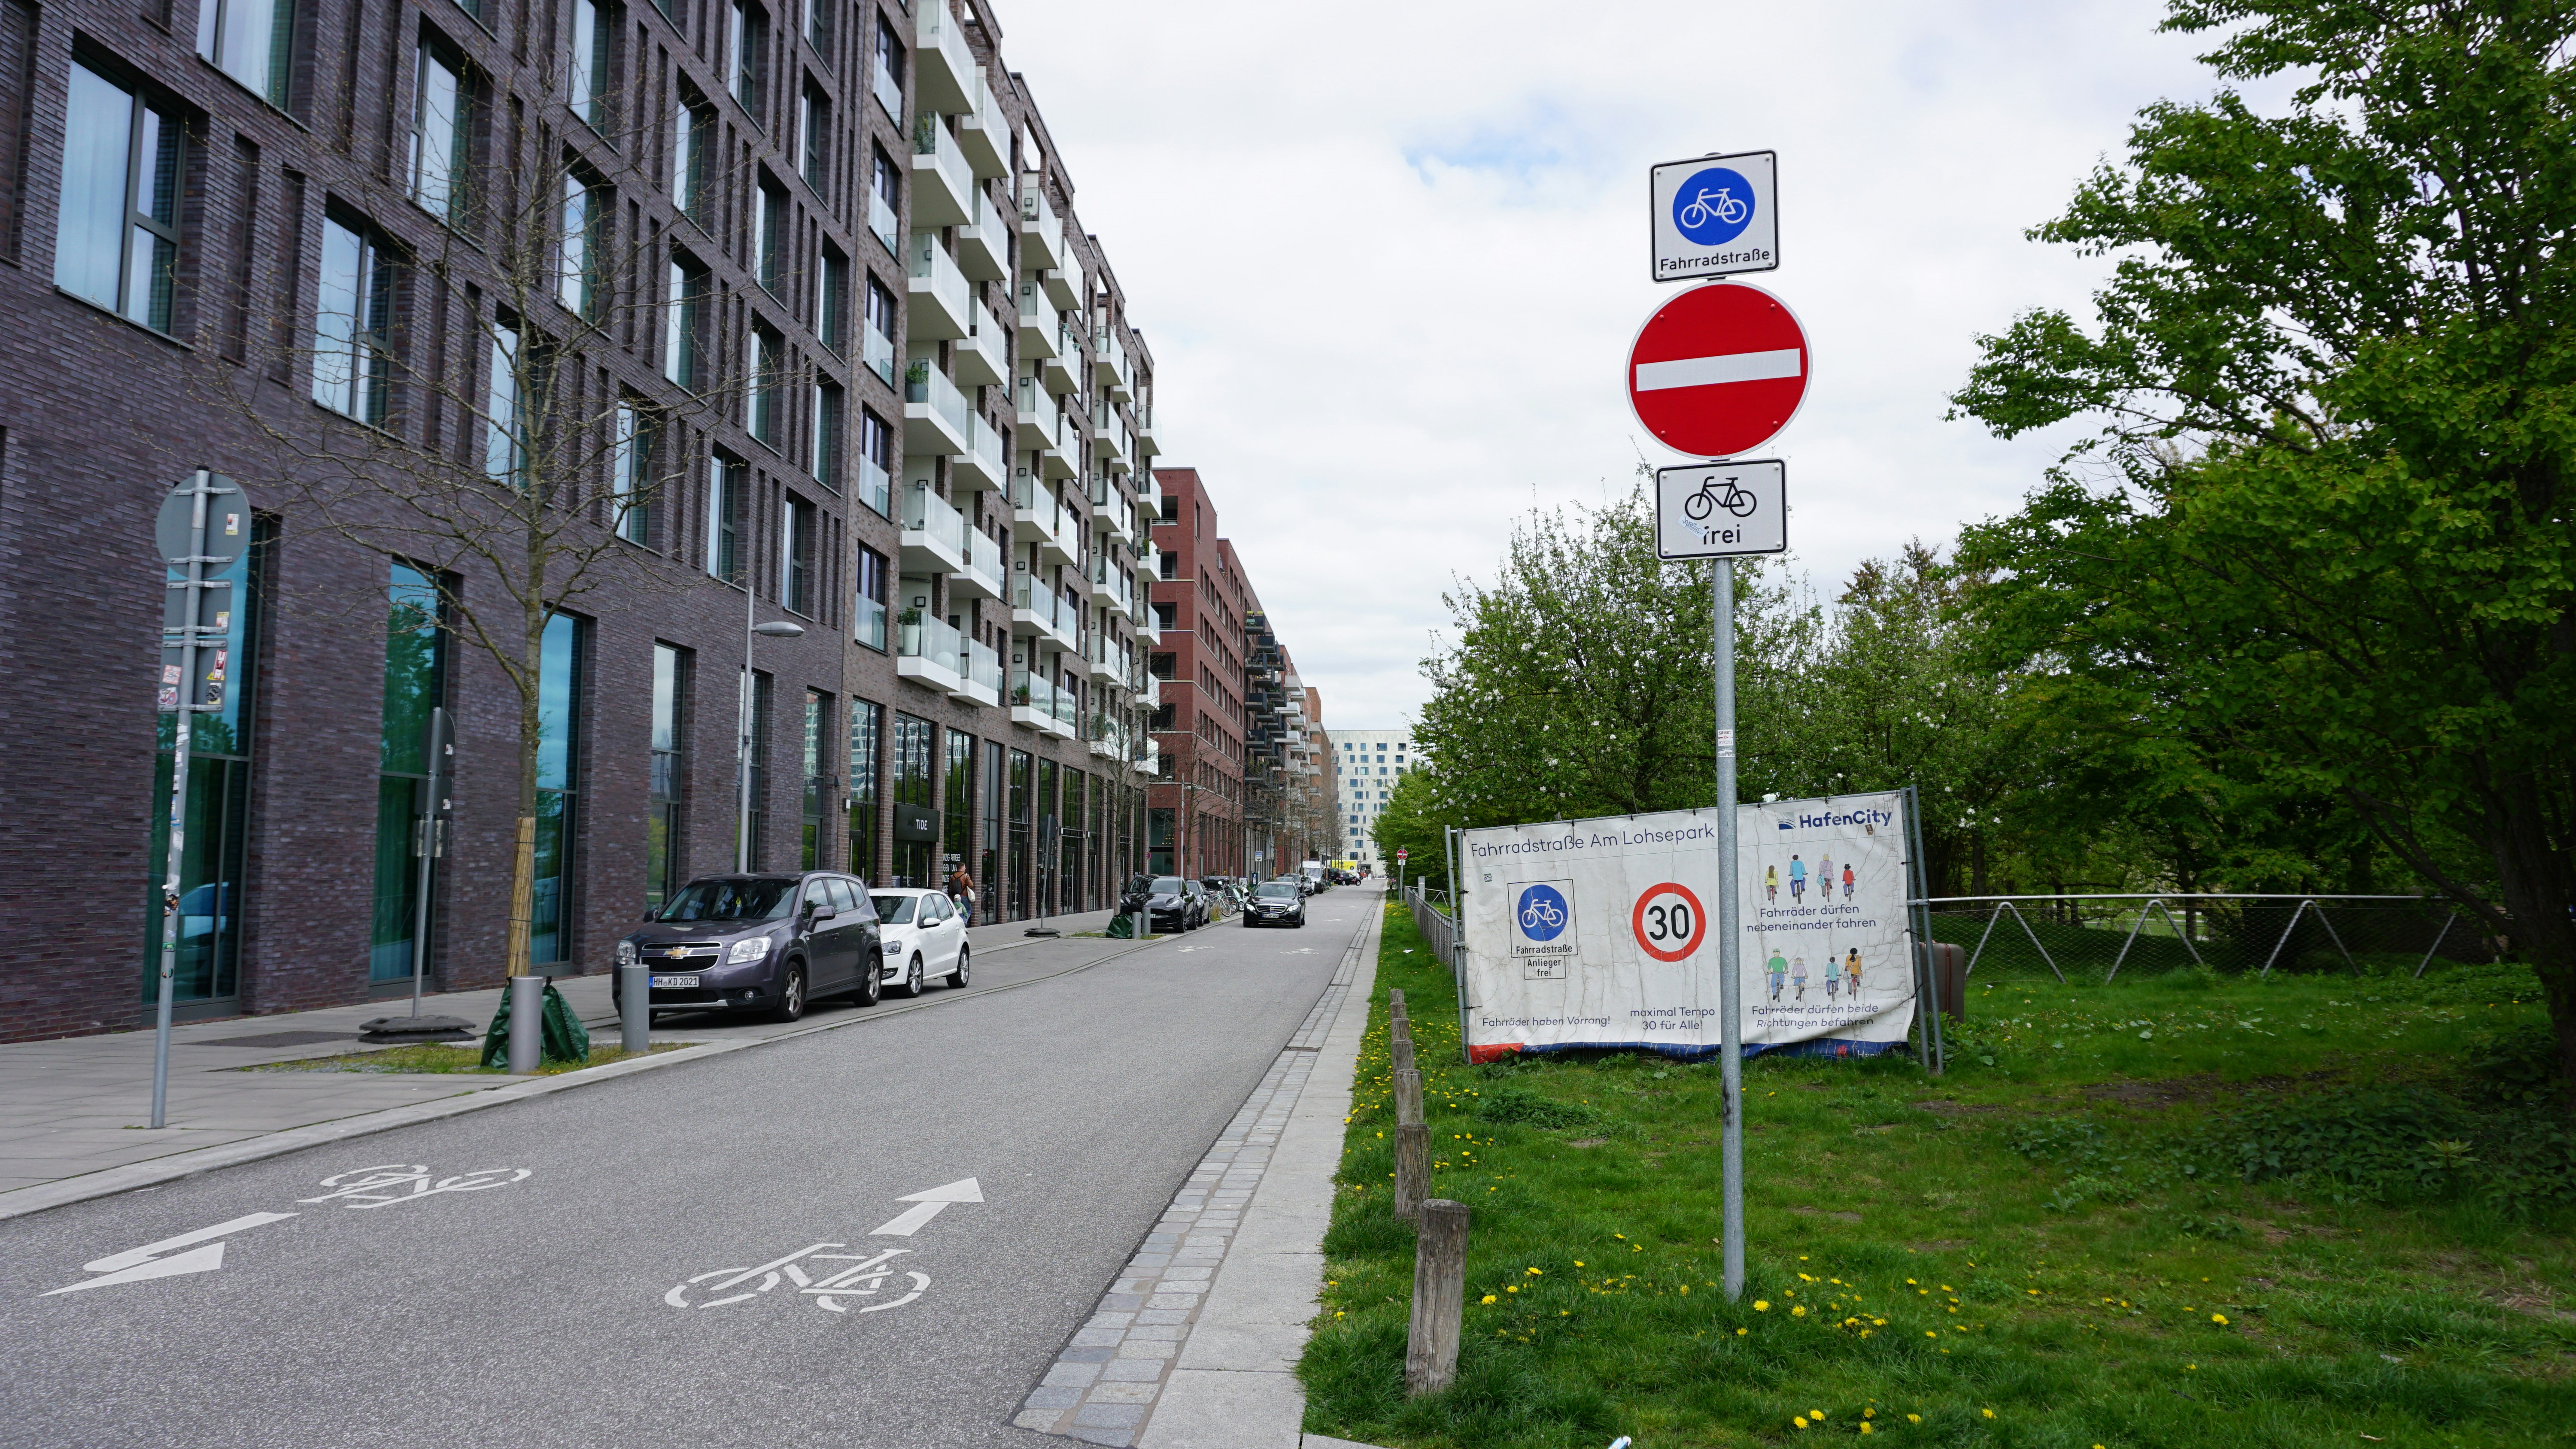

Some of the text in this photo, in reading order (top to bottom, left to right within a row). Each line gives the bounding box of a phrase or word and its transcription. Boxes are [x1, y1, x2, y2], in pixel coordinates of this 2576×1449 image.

[1661, 248, 1770, 271] Fahrradstraße
[1704, 524, 1740, 545] frei
[916, 819, 927, 830] TIDE
[1799, 809, 1892, 828] HafenCity
[1471, 823, 1715, 857] Fahrradstraße Am Lohsepark
[1760, 903, 1859, 918] Fahrräder dürfen
[1648, 904, 1689, 940] 30
[1747, 919, 1876, 932] nebeneinander fahren
[1516, 944, 1572, 954] Fahrradstraße
[1527, 958, 1561, 968] Anlieger
[1537, 968, 1551, 976] frei
[679, 978, 697, 986] 2021
[1630, 1007, 1715, 1019] maximal Tempo
[1752, 1003, 1879, 1015] Fahrräder dürfen beide
[1482, 1016, 1610, 1028] Fahrräder haben Vorrang!
[1642, 1020, 1703, 1030] 30 für Alle!
[1756, 1017, 1874, 1030] Richtungen befahren
